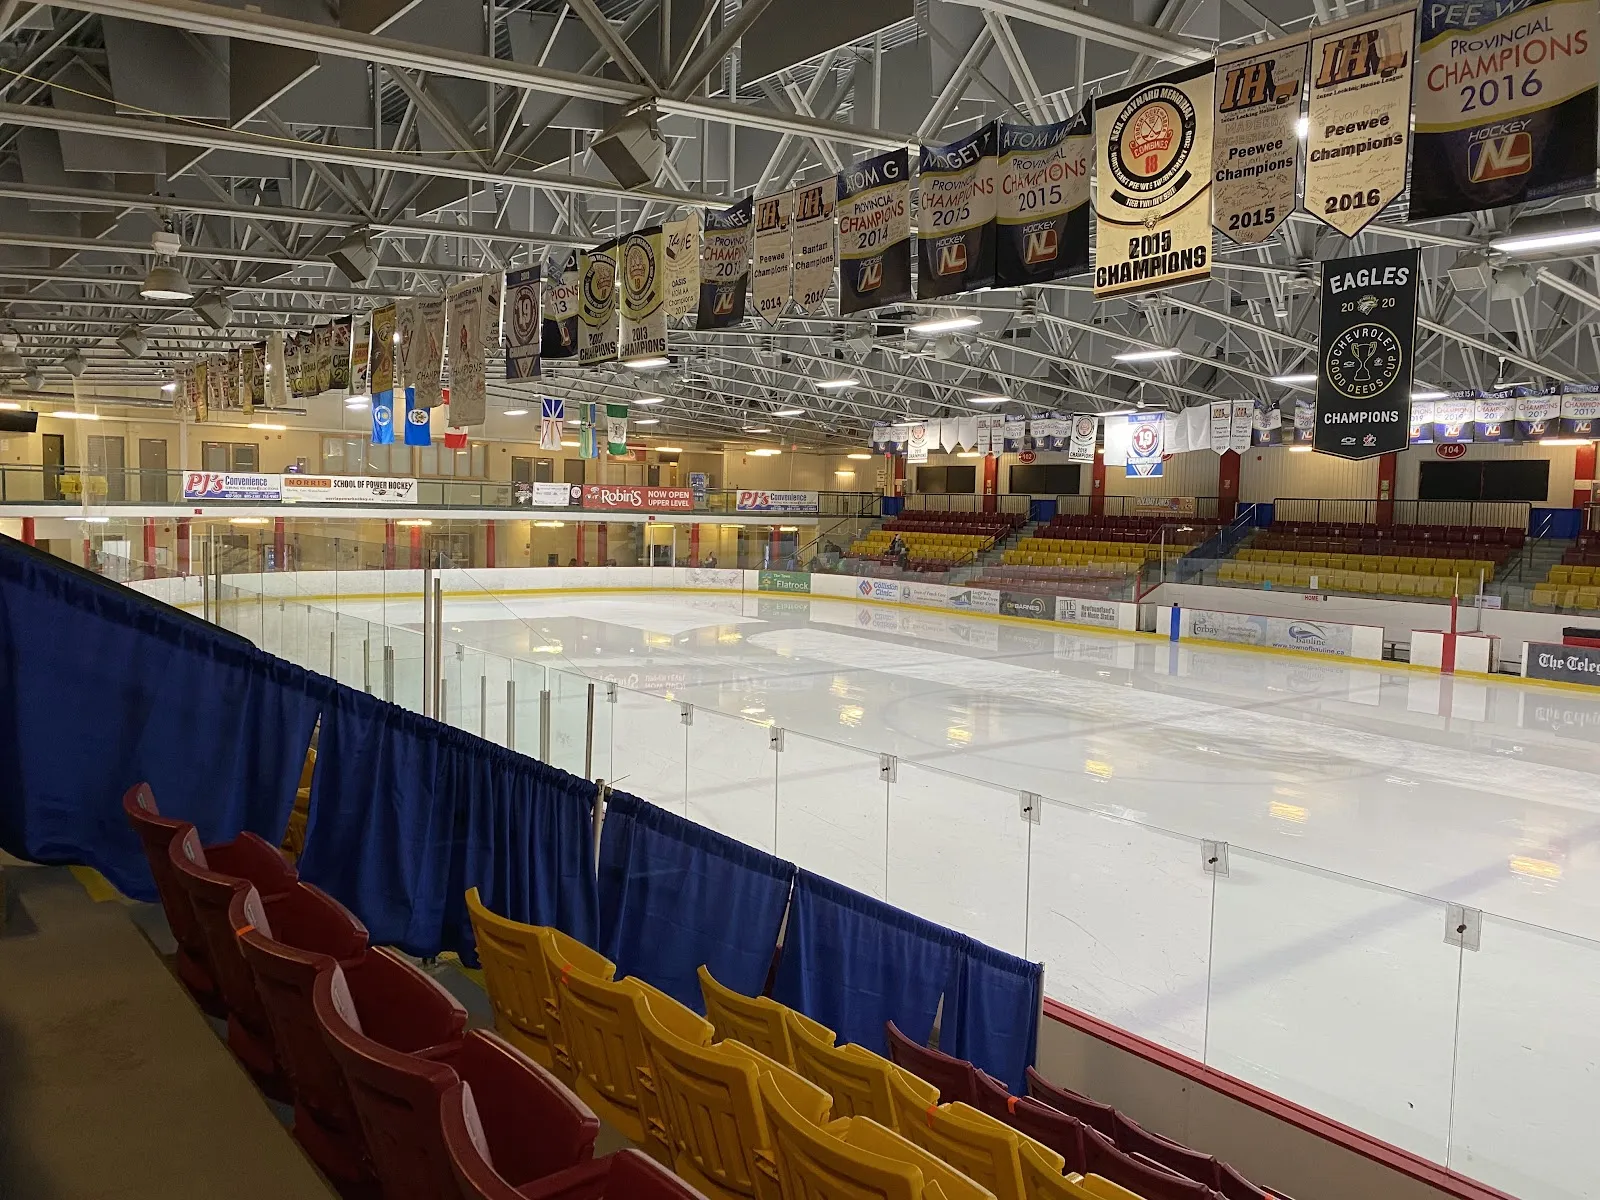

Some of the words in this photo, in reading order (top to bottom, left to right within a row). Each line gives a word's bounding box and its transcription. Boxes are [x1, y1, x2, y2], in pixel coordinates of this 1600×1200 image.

[1431, 4, 1482, 29] PEE
[1451, 16, 1553, 58] PROVINCIAL
[1427, 29, 1589, 92] CHAMPIONS
[1460, 69, 1543, 113] 2016
[1160, 88, 1194, 121] MEMORIAL
[1325, 114, 1390, 139] Peewee
[1468, 119, 1532, 143] HOCKEY
[1003, 130, 1048, 149] ATOM
[1310, 133, 1403, 163] Champions
[1229, 139, 1283, 161] Peewee
[846, 167, 880, 194] ATOM
[883, 161, 899, 179] G
[1002, 158, 1086, 195] CHAMPIONS
[1216, 157, 1293, 182] Champions
[921, 178, 994, 211] CHAMPIONS
[1018, 185, 1062, 212] 2015
[1324, 188, 1381, 214] 2016
[854, 193, 894, 215] PROVINCIAL
[839, 200, 904, 234] CHAMPIONS
[932, 203, 970, 226] 2015
[1229, 207, 1276, 230] 2015
[1023, 220, 1057, 234] HOCKEY
[858, 226, 888, 249] 2014
[936, 235, 966, 248] HOCKEY
[1129, 230, 1172, 260] 2015
[802, 241, 828, 255] Bantam
[759, 252, 785, 264] Peewee
[795, 254, 834, 270] Champions
[1096, 245, 1207, 288] CHAMPIONS
[754, 264, 788, 278] Champions
[1329, 267, 1410, 295] EAGLES
[760, 297, 782, 311] 2014
[804, 289, 825, 305] 2014
[1341, 302, 1354, 313] 20
[1381, 297, 1396, 309] 20
[632, 326, 648, 340] 2013
[579, 342, 617, 361] CHAMPIONS
[620, 338, 666, 357] CHAMPIONS
[1333, 328, 1396, 357] CHEVROLET
[1331, 358, 1346, 387] GOOD
[1347, 378, 1384, 395] DEEDS
[1383, 355, 1397, 377] CUP
[1436, 406, 1473, 414] CHAMPIONS
[1518, 401, 1558, 411] CHAMPIONS
[1564, 400, 1600, 408] CHAMPION
[1573, 408, 1596, 416] 2019
[1324, 410, 1399, 425] CHAMPIONS
[1444, 413, 1463, 421] 2019
[1528, 410, 1548, 418] 2019
[1139, 430, 1152, 447] 19
[1444, 446, 1459, 454] 104
[225, 475, 268, 487] Convenience
[288, 479, 328, 488] NORRIS
[333, 479, 356, 489] SCHOOL
[357, 480, 364, 489] OF
[365, 480, 388, 490] POWER
[388, 481, 413, 493] HOCKEY
[647, 491, 667, 499] NOW
[668, 491, 690, 499] OPEN
[648, 499, 670, 507] UPPER
[770, 492, 807, 502] Convenience
[776, 580, 809, 591] Flatrock
[1060, 600, 1076, 611] HITS
[1100, 613, 1115, 621] Station
[1193, 620, 1219, 636] torbay
[1272, 642, 1345, 655] www.townofbauline.ca
[1538, 653, 1564, 670] The
[1566, 656, 1600, 676] Teleg
